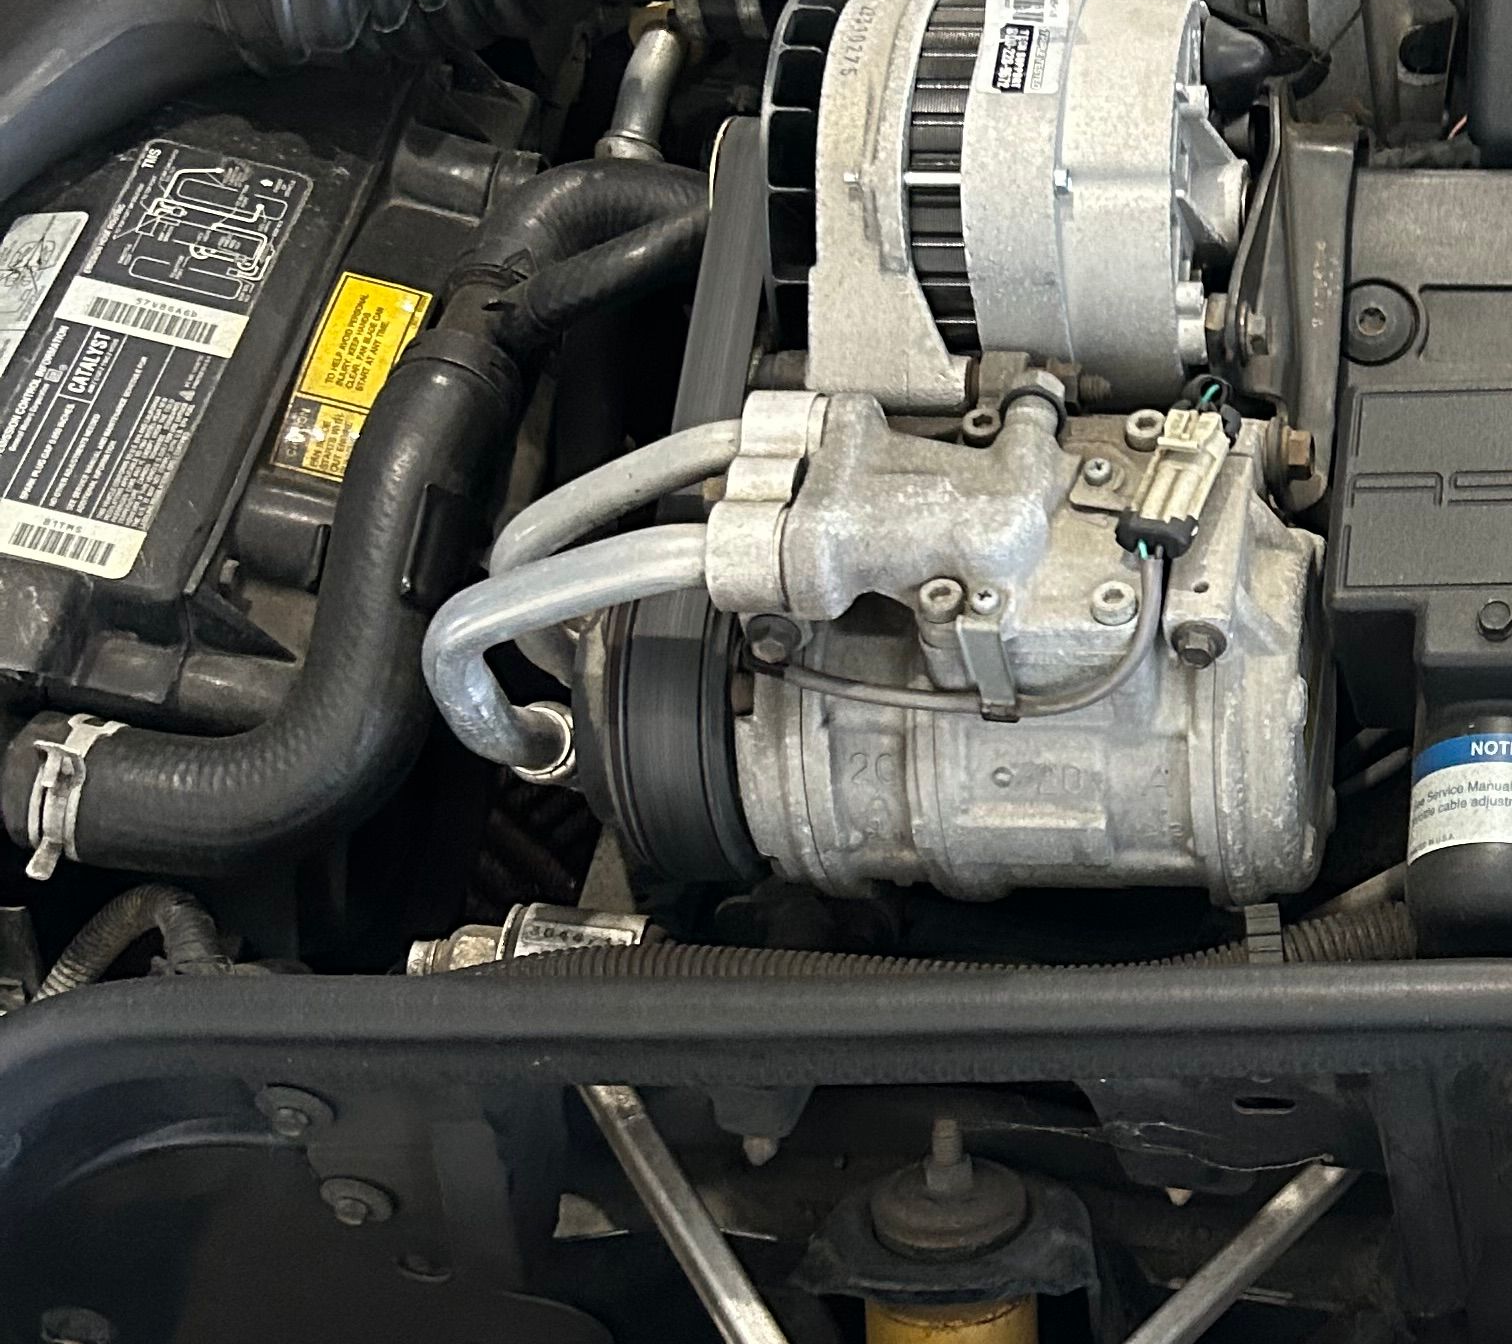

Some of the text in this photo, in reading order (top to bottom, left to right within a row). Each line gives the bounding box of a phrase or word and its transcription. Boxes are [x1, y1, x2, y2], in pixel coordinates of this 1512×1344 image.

[141, 147, 161, 168] TMS
[324, 292, 370, 384] TO HELP AVOID PERSONAL
[347, 336, 361, 357] KEEP
[355, 311, 372, 336] HANDS
[356, 344, 368, 361] FAN
[362, 320, 378, 345] BLADE
[372, 306, 384, 321] CAN
[369, 338, 381, 354] ANY
[66, 331, 110, 393] CATALYST
[365, 353, 375, 365] AT
[354, 366, 371, 391] START
[1427, 784, 1464, 804] Service
[1438, 798, 1468, 813] cable
